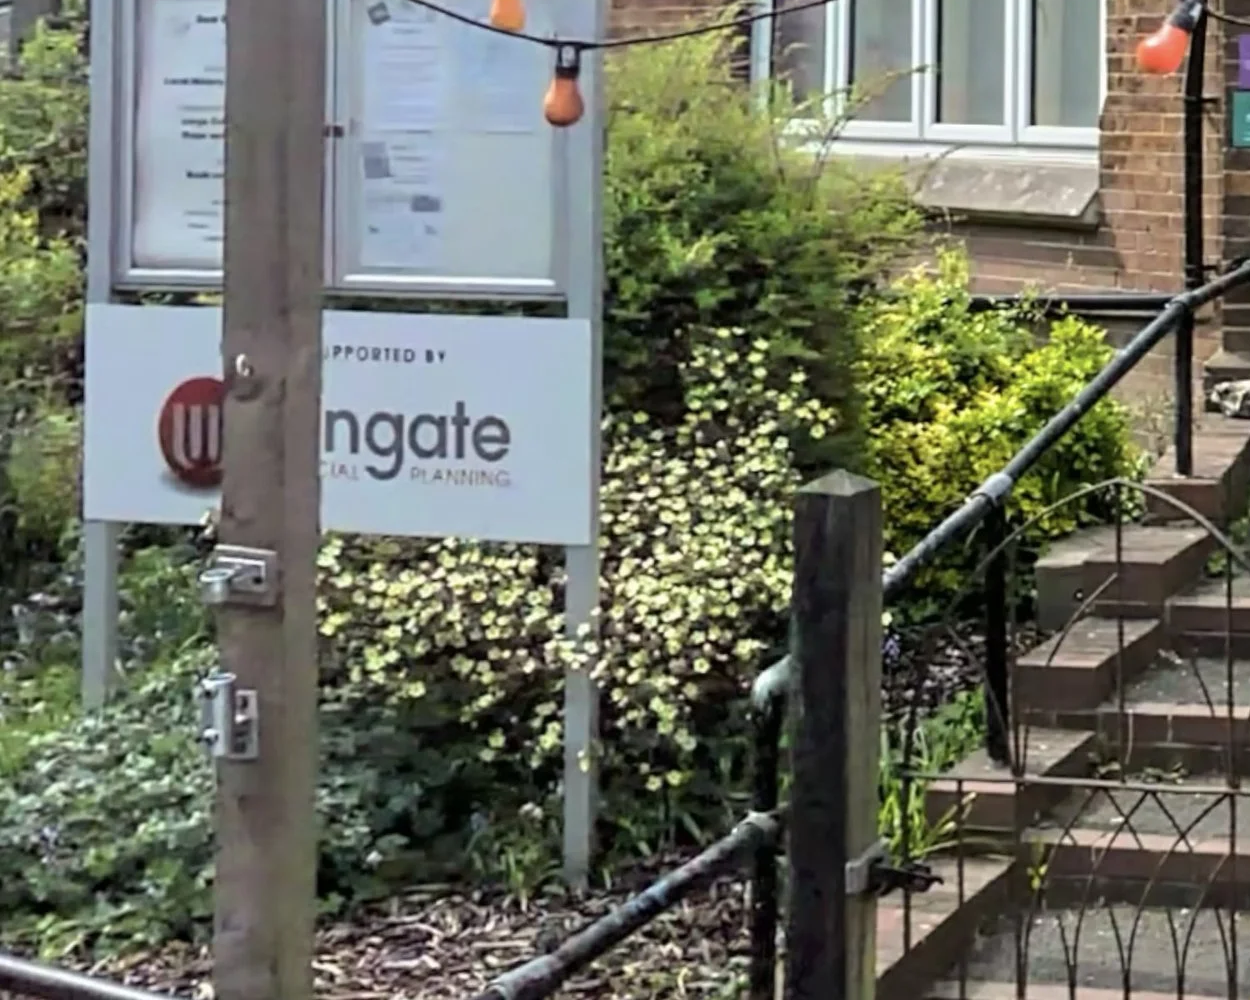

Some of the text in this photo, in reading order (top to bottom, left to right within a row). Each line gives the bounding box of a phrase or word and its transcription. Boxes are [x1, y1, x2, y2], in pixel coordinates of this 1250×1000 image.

[425, 349, 446, 364] BY
[325, 400, 511, 481] ngate
[410, 467, 511, 488] PLANNING
